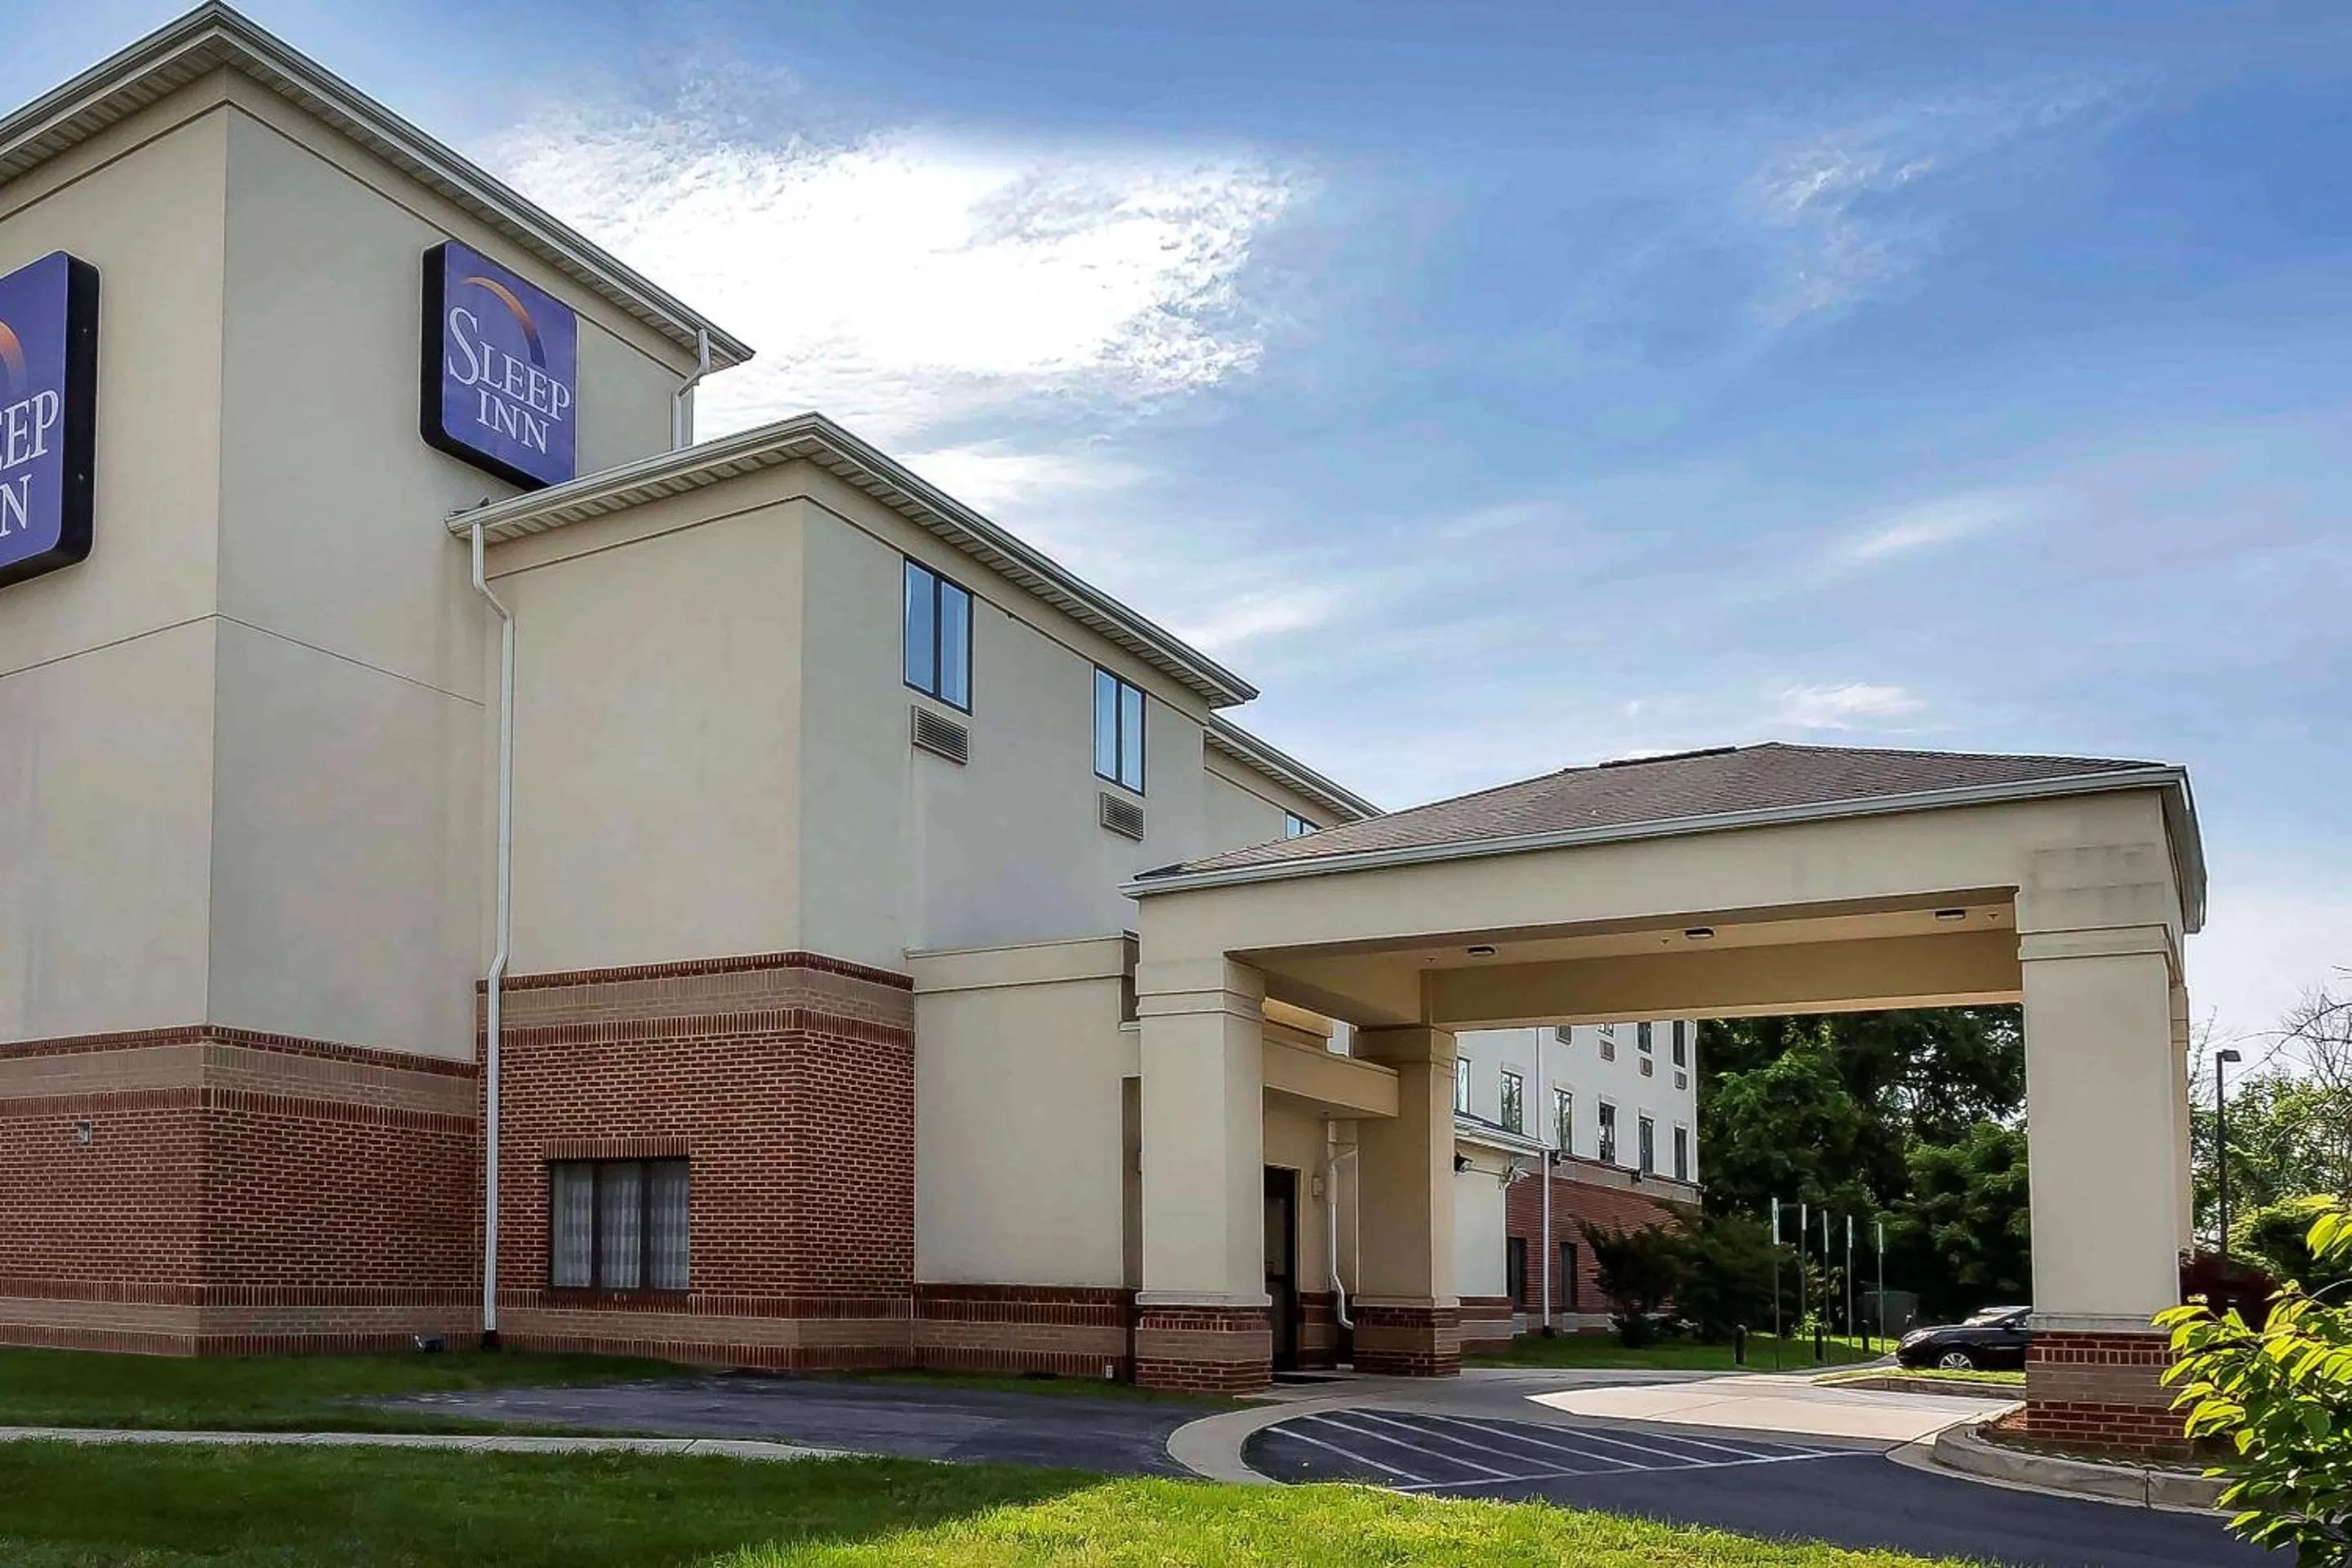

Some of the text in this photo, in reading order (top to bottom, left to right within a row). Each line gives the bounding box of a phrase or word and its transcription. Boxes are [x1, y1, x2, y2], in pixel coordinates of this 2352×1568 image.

[448, 306, 570, 421] SLEEP
[0, 390, 59, 471] EP
[476, 387, 550, 454] INN
